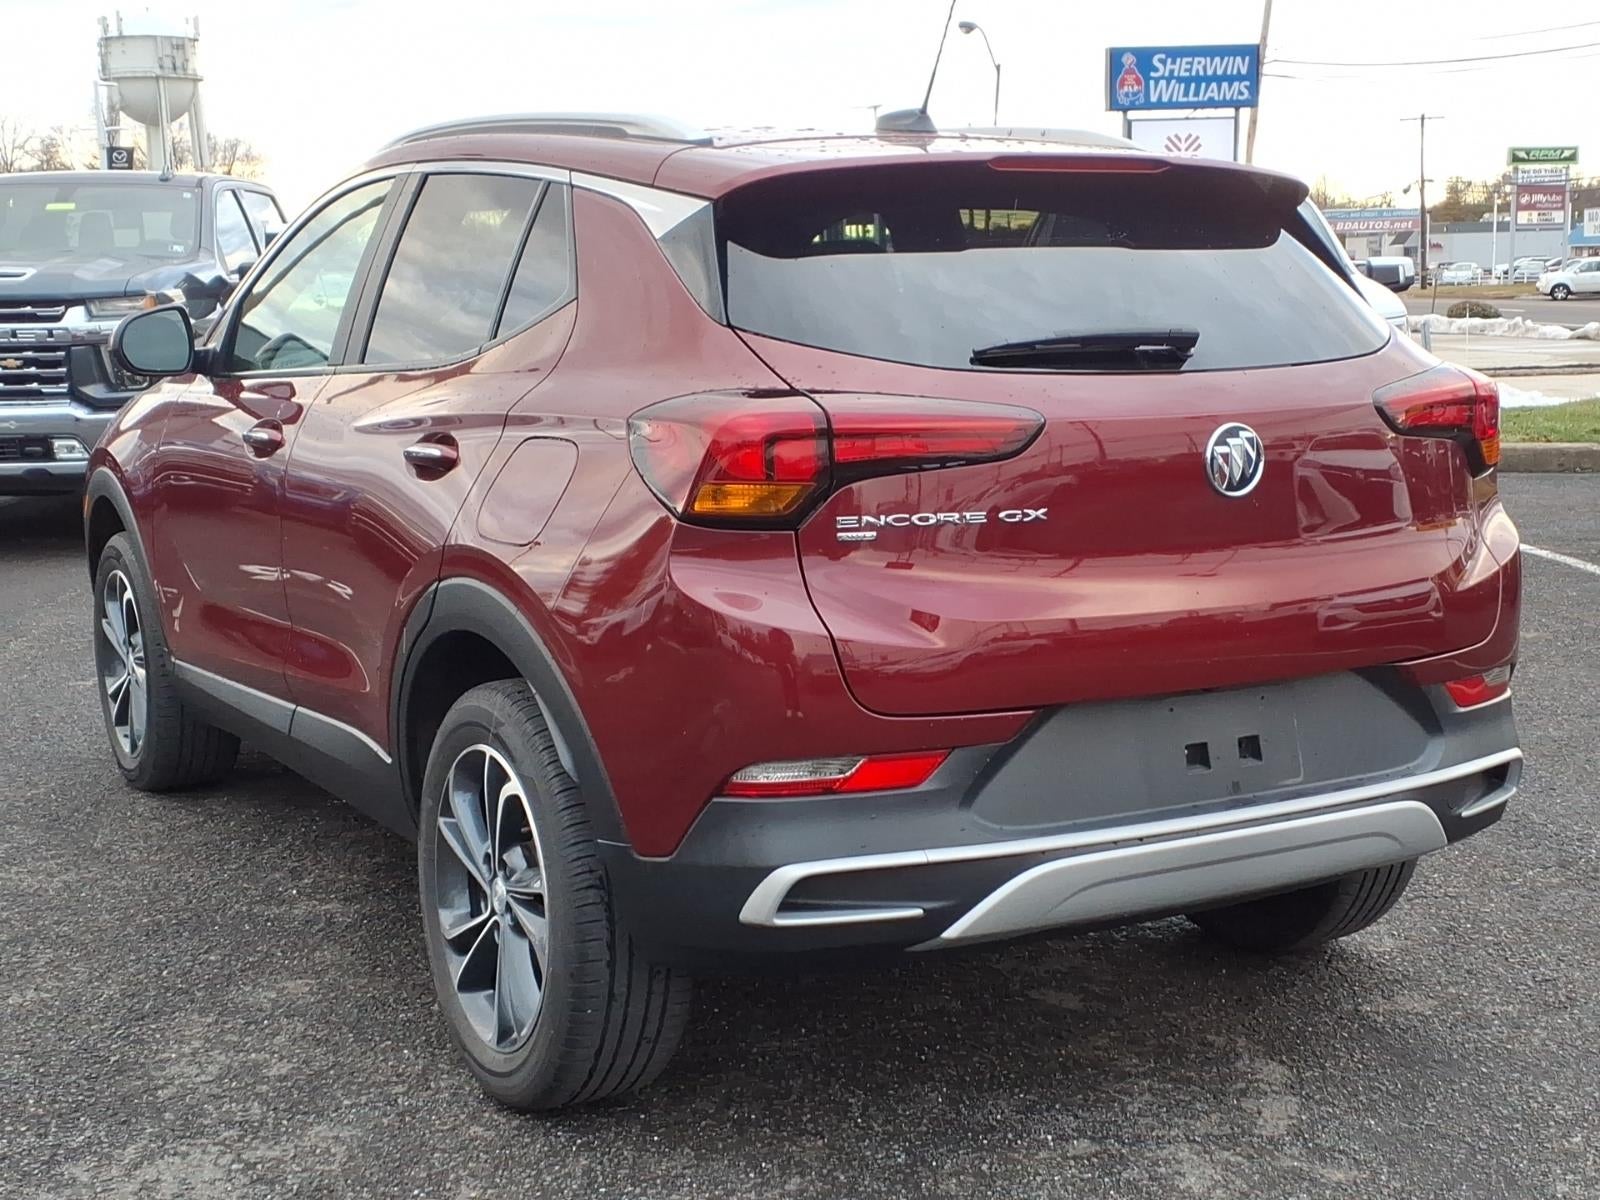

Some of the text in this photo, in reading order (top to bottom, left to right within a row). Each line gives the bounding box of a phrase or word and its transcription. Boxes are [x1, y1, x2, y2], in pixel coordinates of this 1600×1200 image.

[1150, 53, 1250, 78] SHERWIN
[1149, 79, 1250, 103] WILLIAMS
[1529, 149, 1562, 159] RPM
[836, 507, 1049, 530] ENCORE GX
